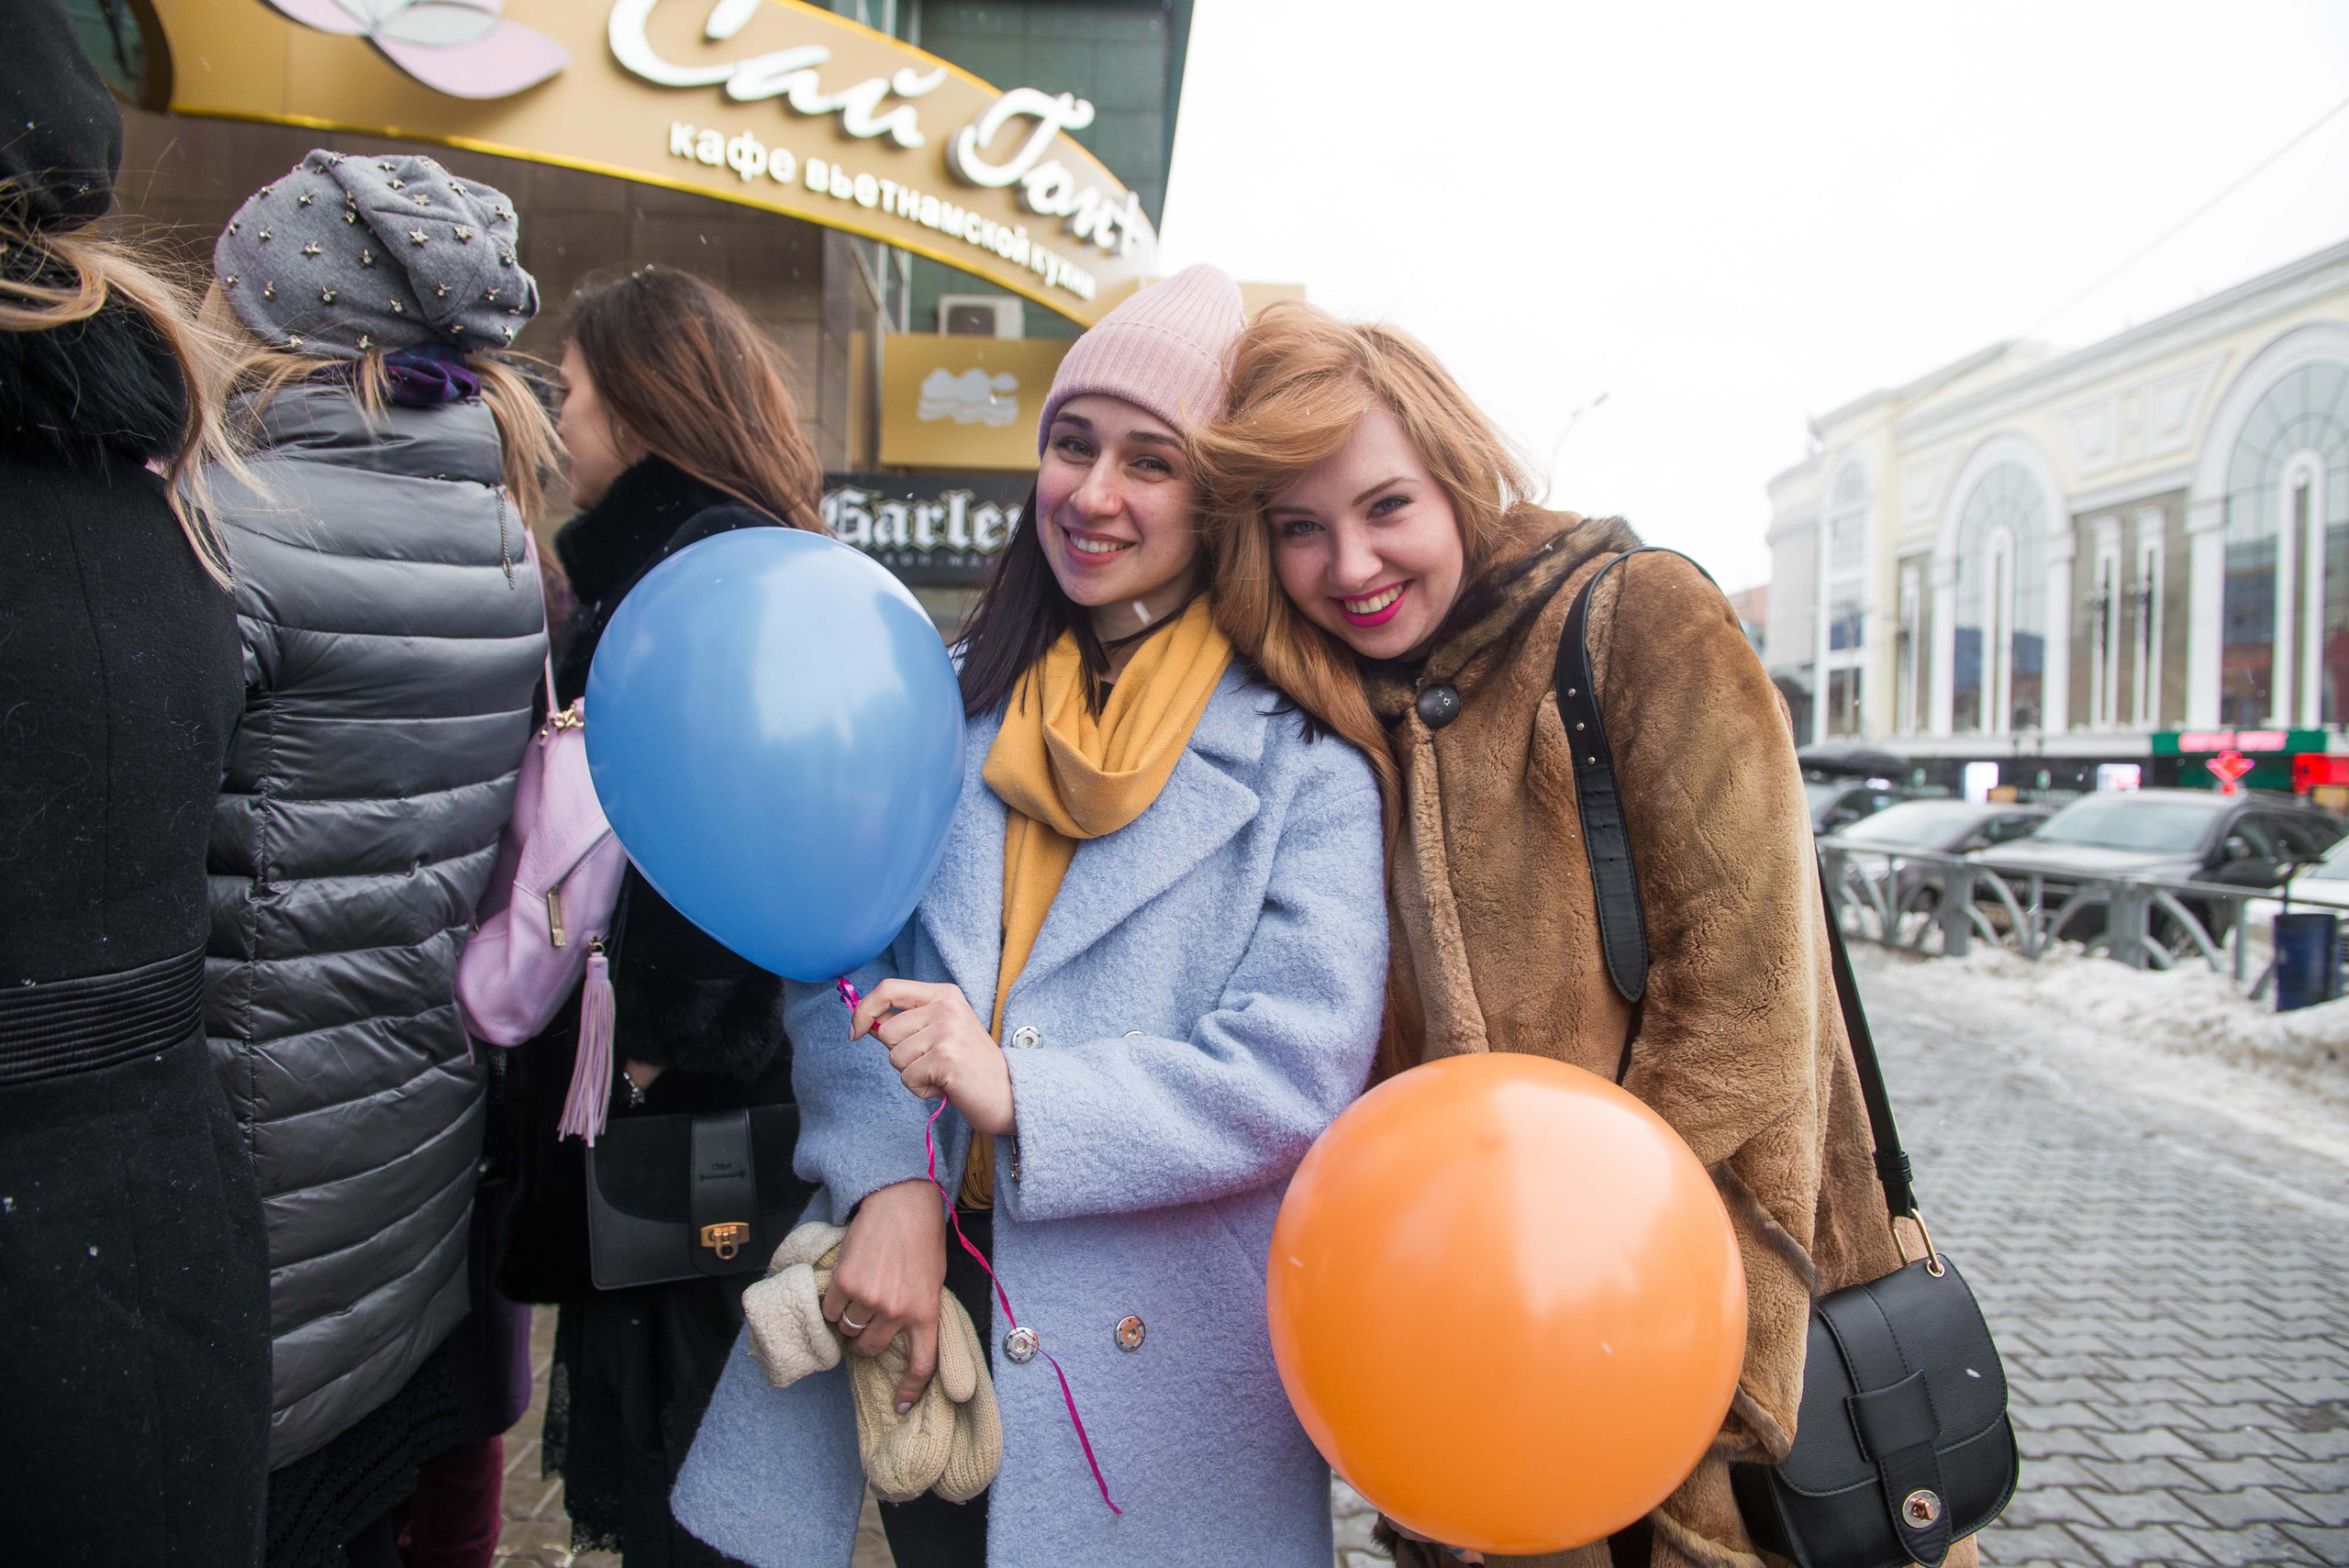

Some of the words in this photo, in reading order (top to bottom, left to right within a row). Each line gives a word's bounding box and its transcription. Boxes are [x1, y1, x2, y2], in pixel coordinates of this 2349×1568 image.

[607, 0, 947, 149] Сай
[669, 120, 796, 182] кафе
[805, 156, 1030, 267] вьетнамской
